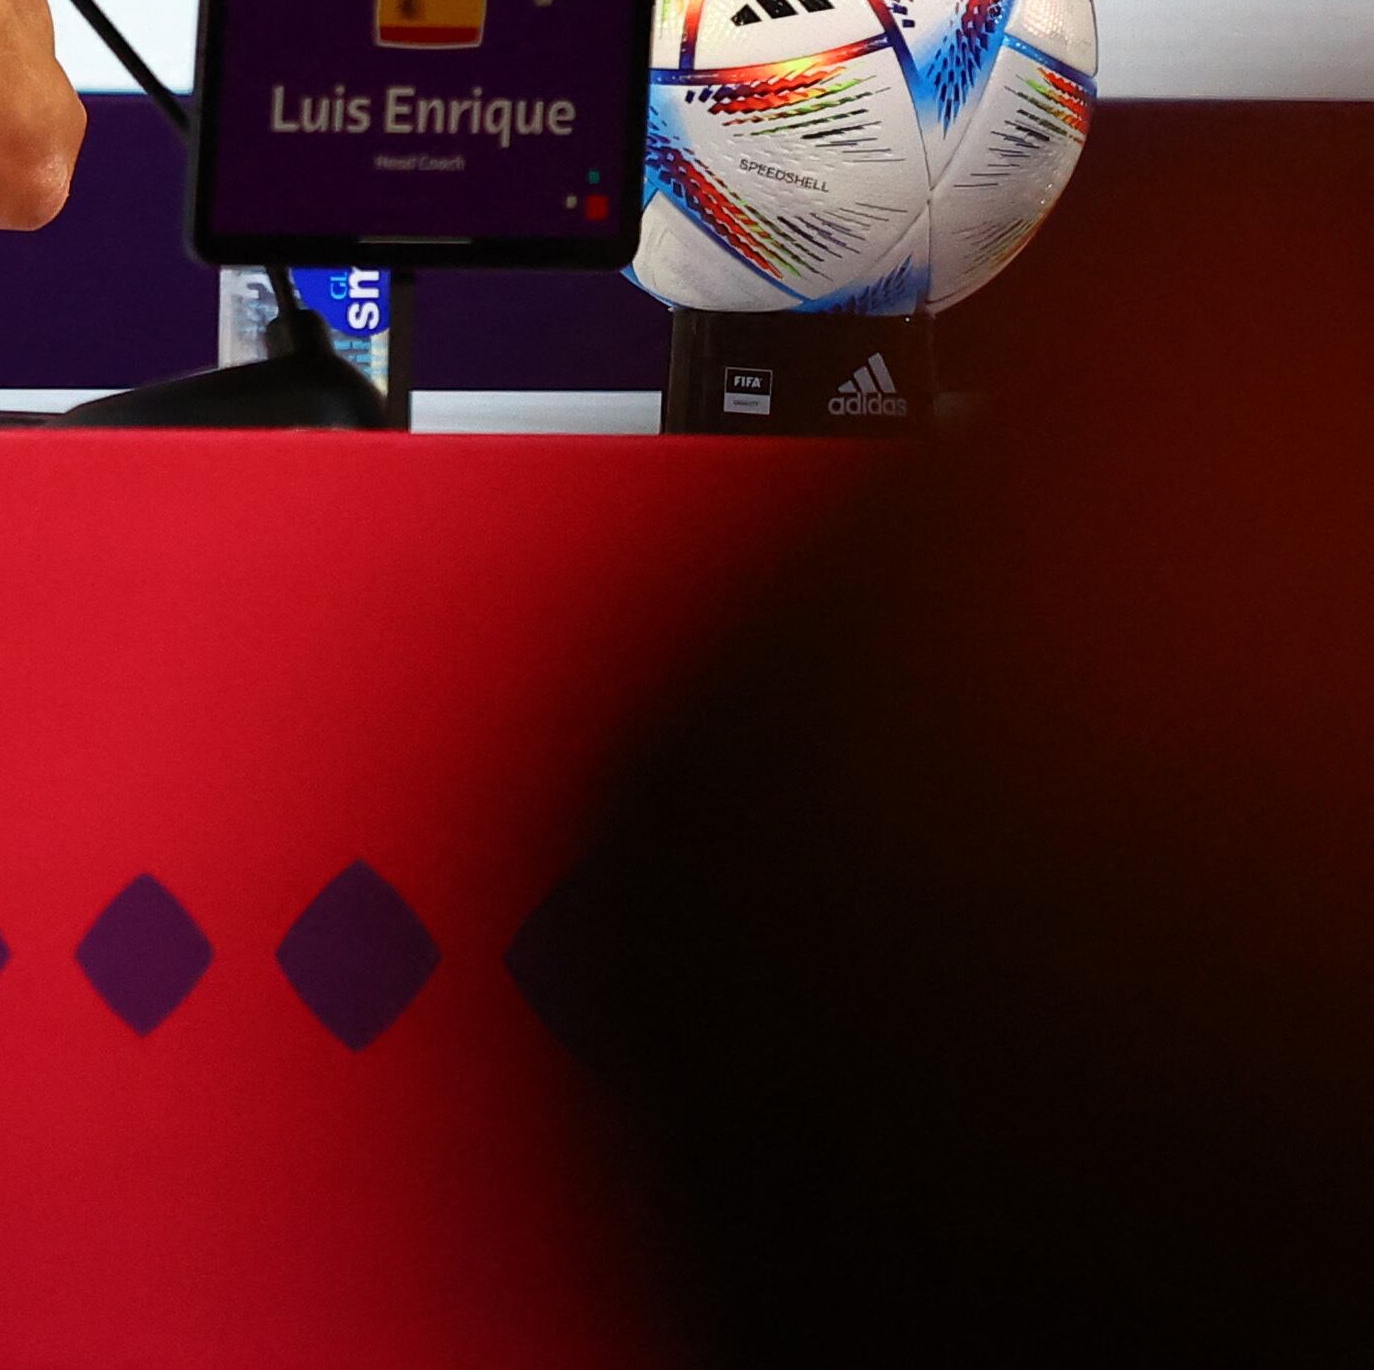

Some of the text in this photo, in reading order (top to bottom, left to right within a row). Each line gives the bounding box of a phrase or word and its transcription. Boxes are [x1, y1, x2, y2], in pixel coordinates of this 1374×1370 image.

[272, 85, 575, 148] Luis Enrique
[739, 159, 829, 193] SPEEDSHELL
[732, 375, 764, 389] FIFA
[827, 392, 908, 417] adidas
